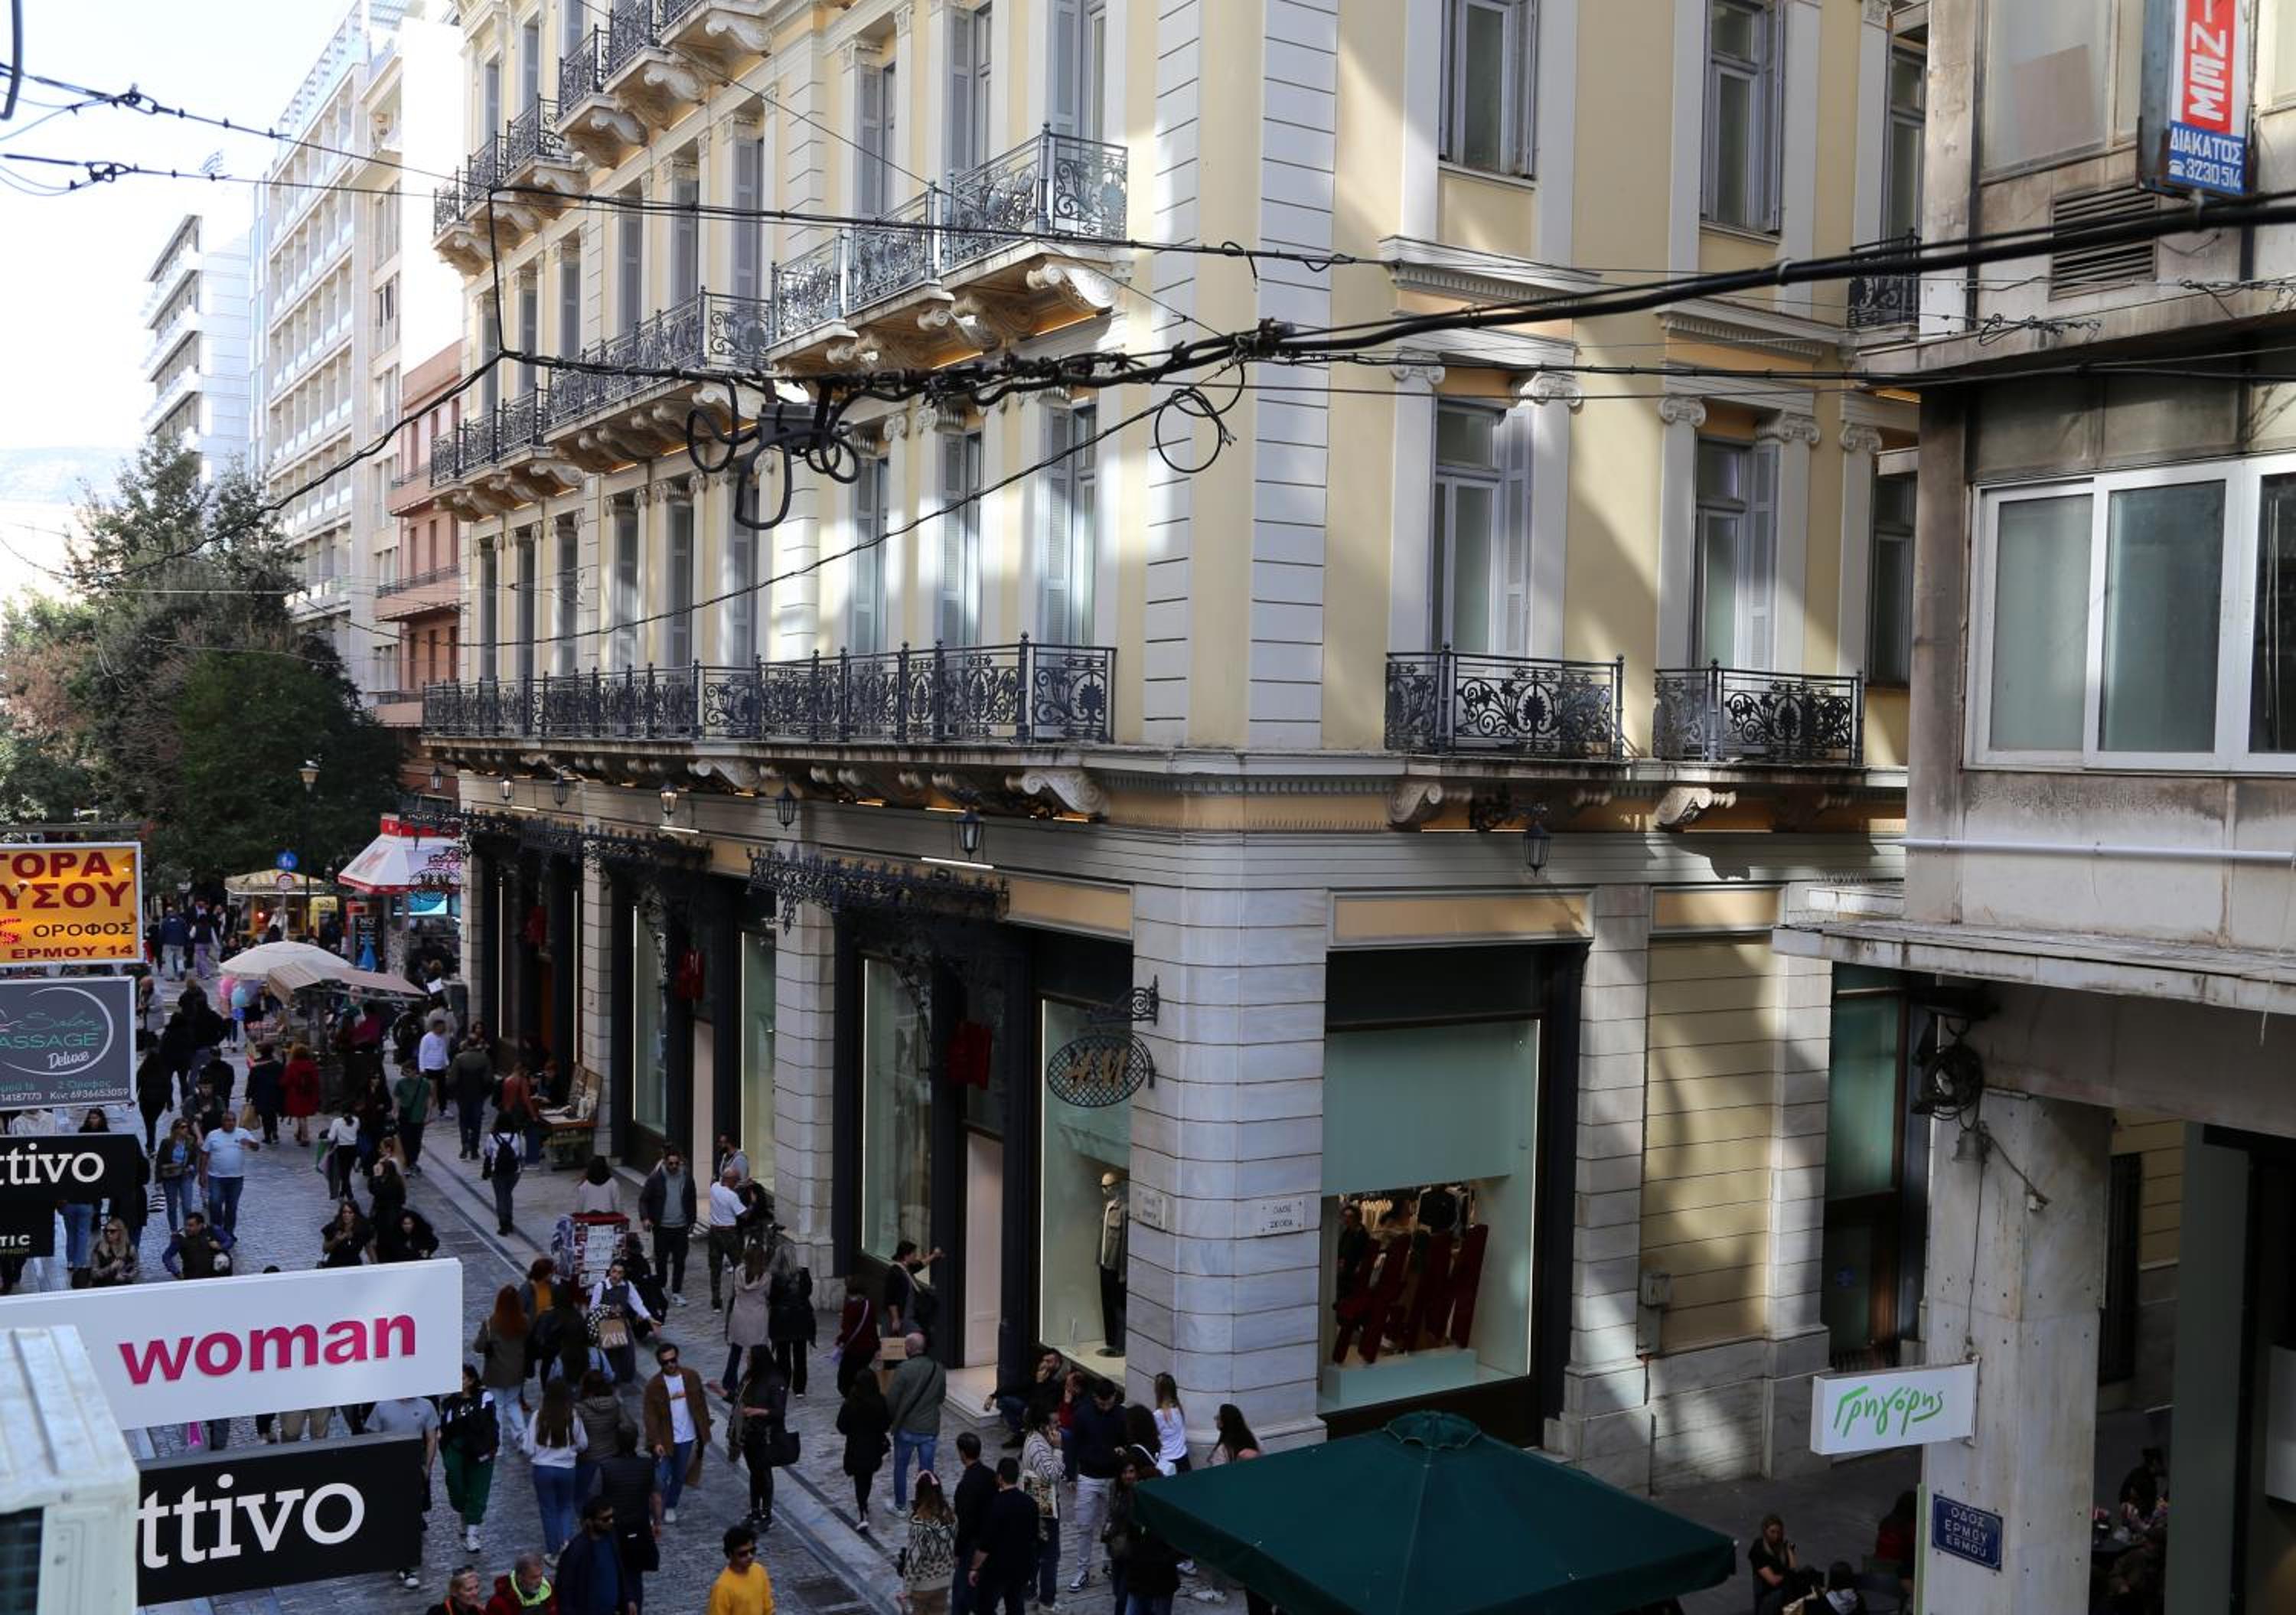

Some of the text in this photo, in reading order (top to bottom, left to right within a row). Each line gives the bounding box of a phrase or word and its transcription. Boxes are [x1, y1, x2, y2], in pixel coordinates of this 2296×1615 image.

[2170, 127, 2243, 166] ΔΙΑΚΑΤΟΣ
[33, 922, 133, 938] ΟΡΟΦΟΣ
[11, 944, 134, 959] ΕΡΜΟΥ 14
[119, 1313, 416, 1385] woman
[1833, 1385, 1944, 1439] Γρηγόρης
[1950, 1507, 1985, 1528] ΟΔΟΣ
[1945, 1519, 1988, 1543] ΕΡΜΟΥ
[1946, 1535, 1987, 1558] ERMOU
